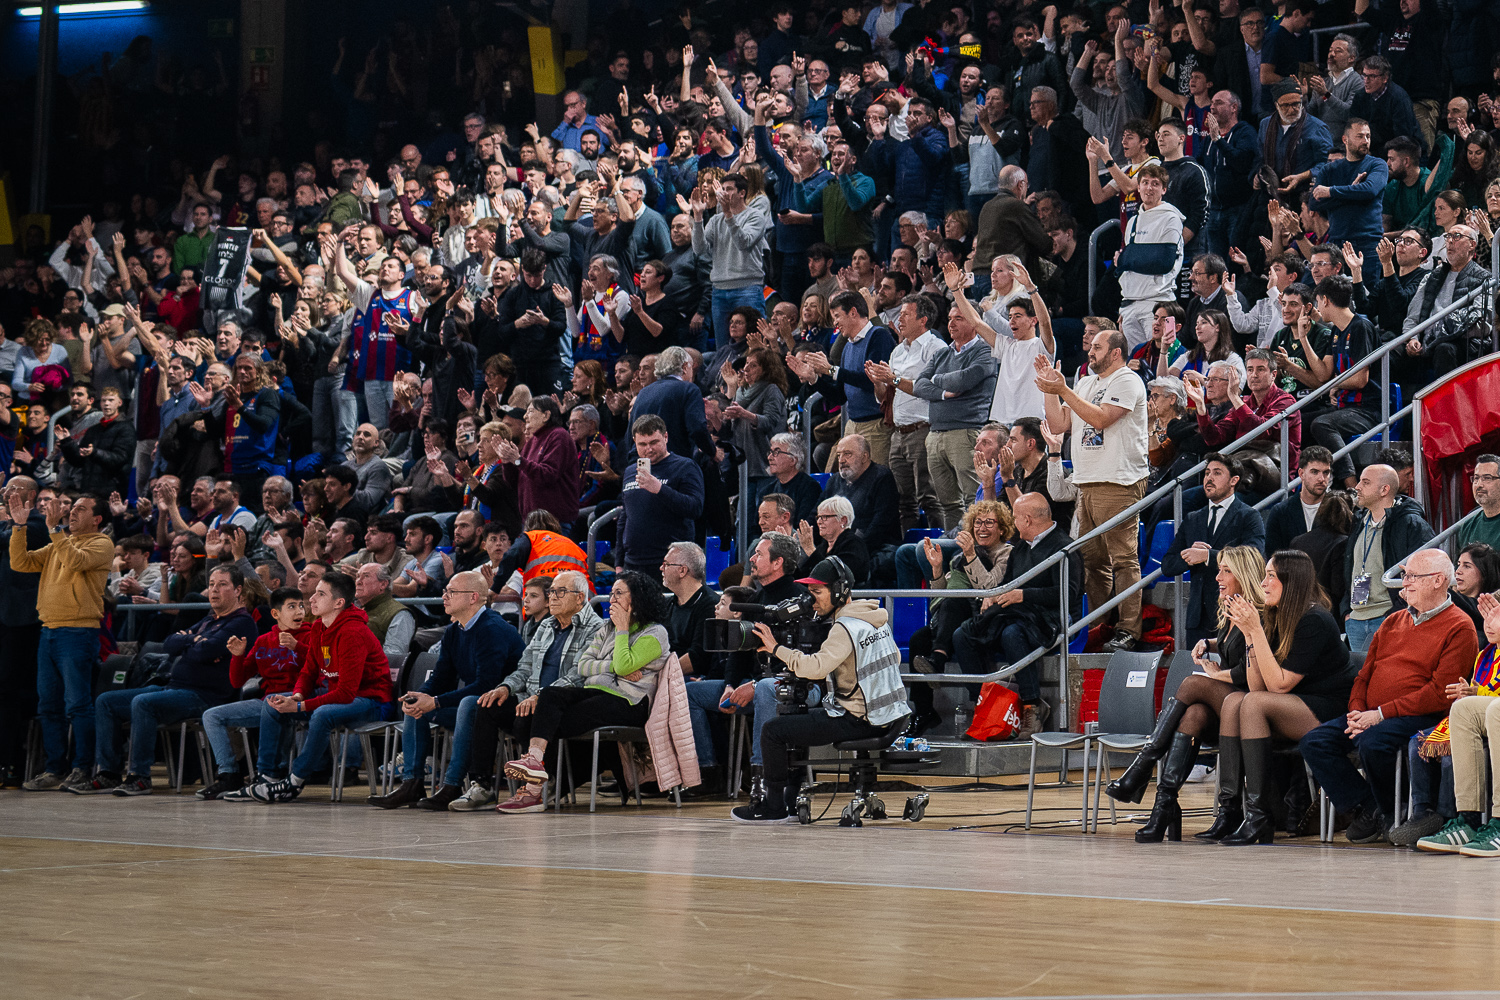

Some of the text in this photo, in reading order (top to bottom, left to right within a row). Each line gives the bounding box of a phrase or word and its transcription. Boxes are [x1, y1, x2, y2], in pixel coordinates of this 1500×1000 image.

[235, 211, 249, 225] 22
[217, 258, 228, 278] 7
[232, 412, 241, 429] 8
